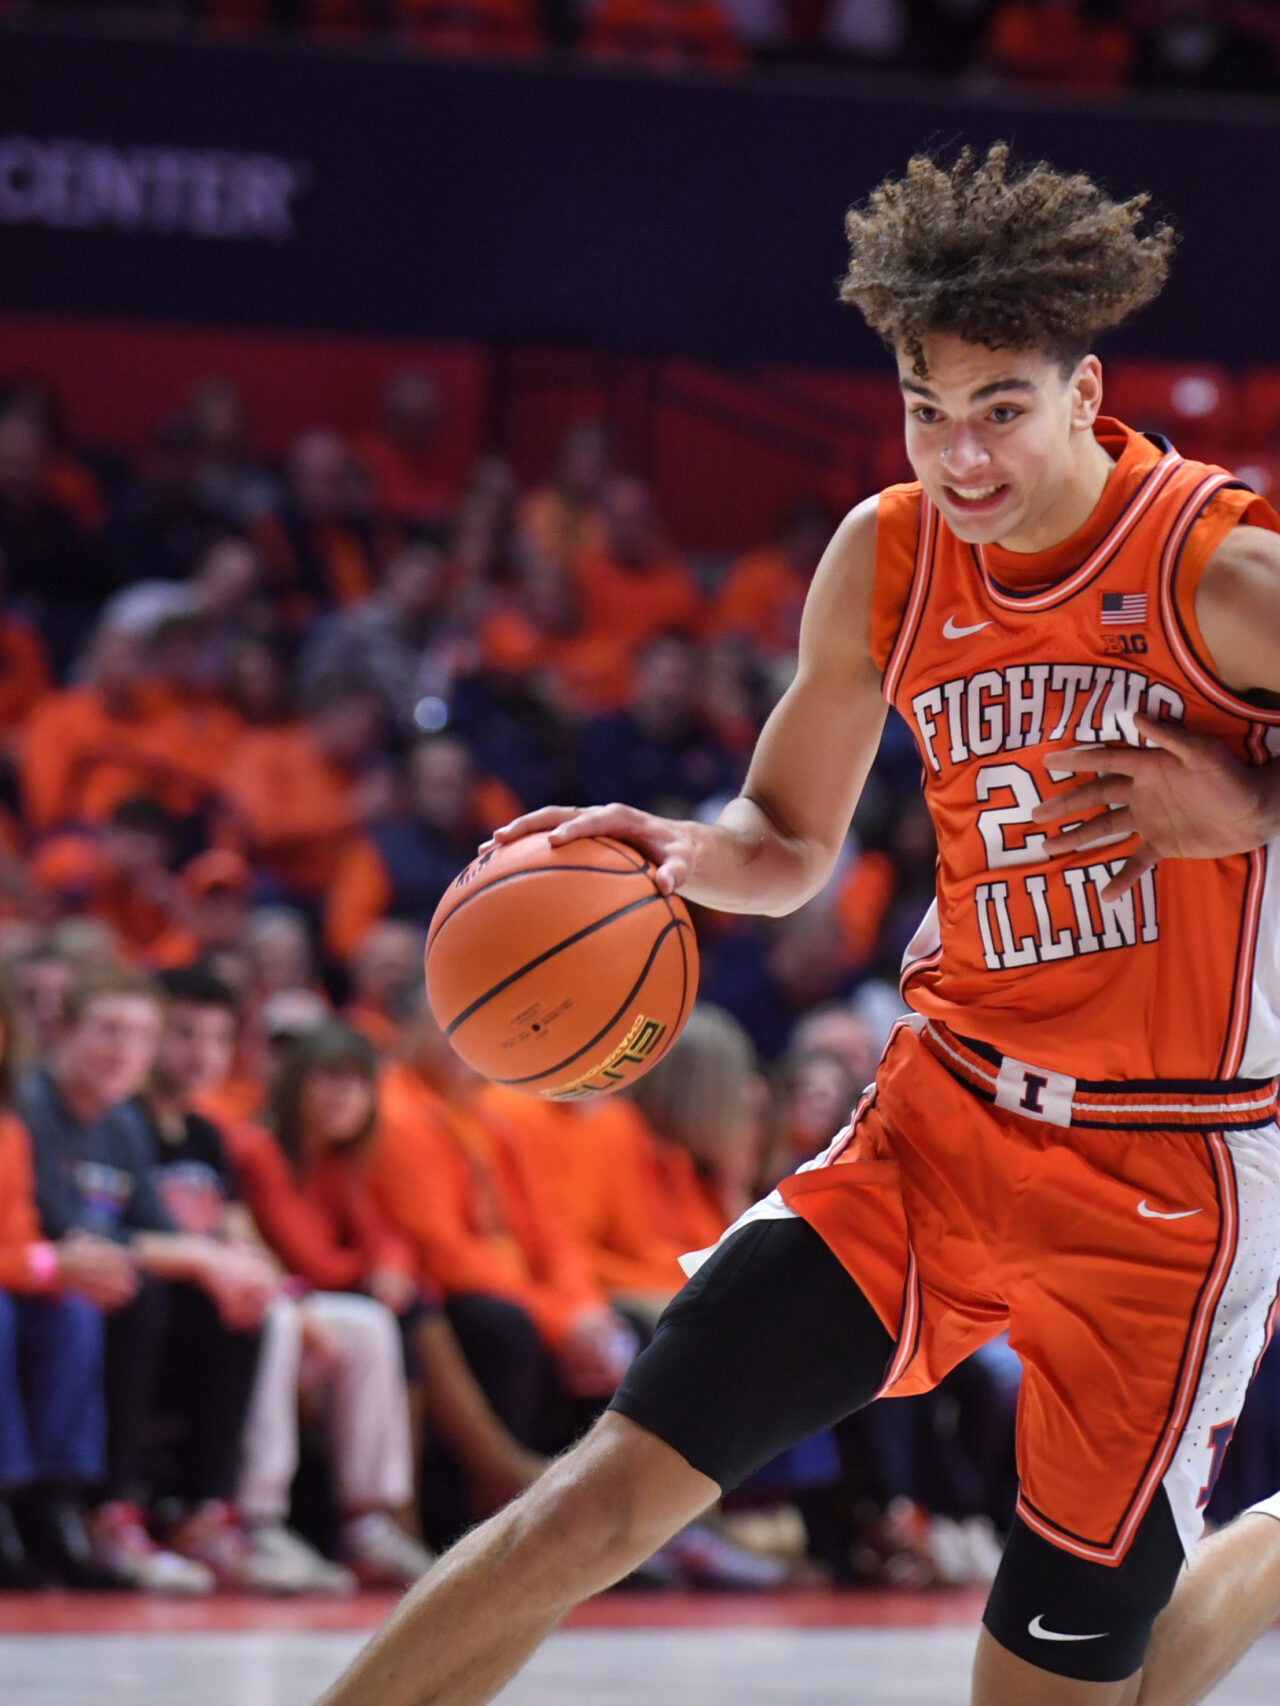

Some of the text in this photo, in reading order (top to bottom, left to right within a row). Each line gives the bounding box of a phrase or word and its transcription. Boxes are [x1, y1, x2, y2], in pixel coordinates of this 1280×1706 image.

[974, 857, 1159, 972] ILLINI
[546, 1016, 668, 1102] ELITE
[1019, 1071, 1047, 1115] I
